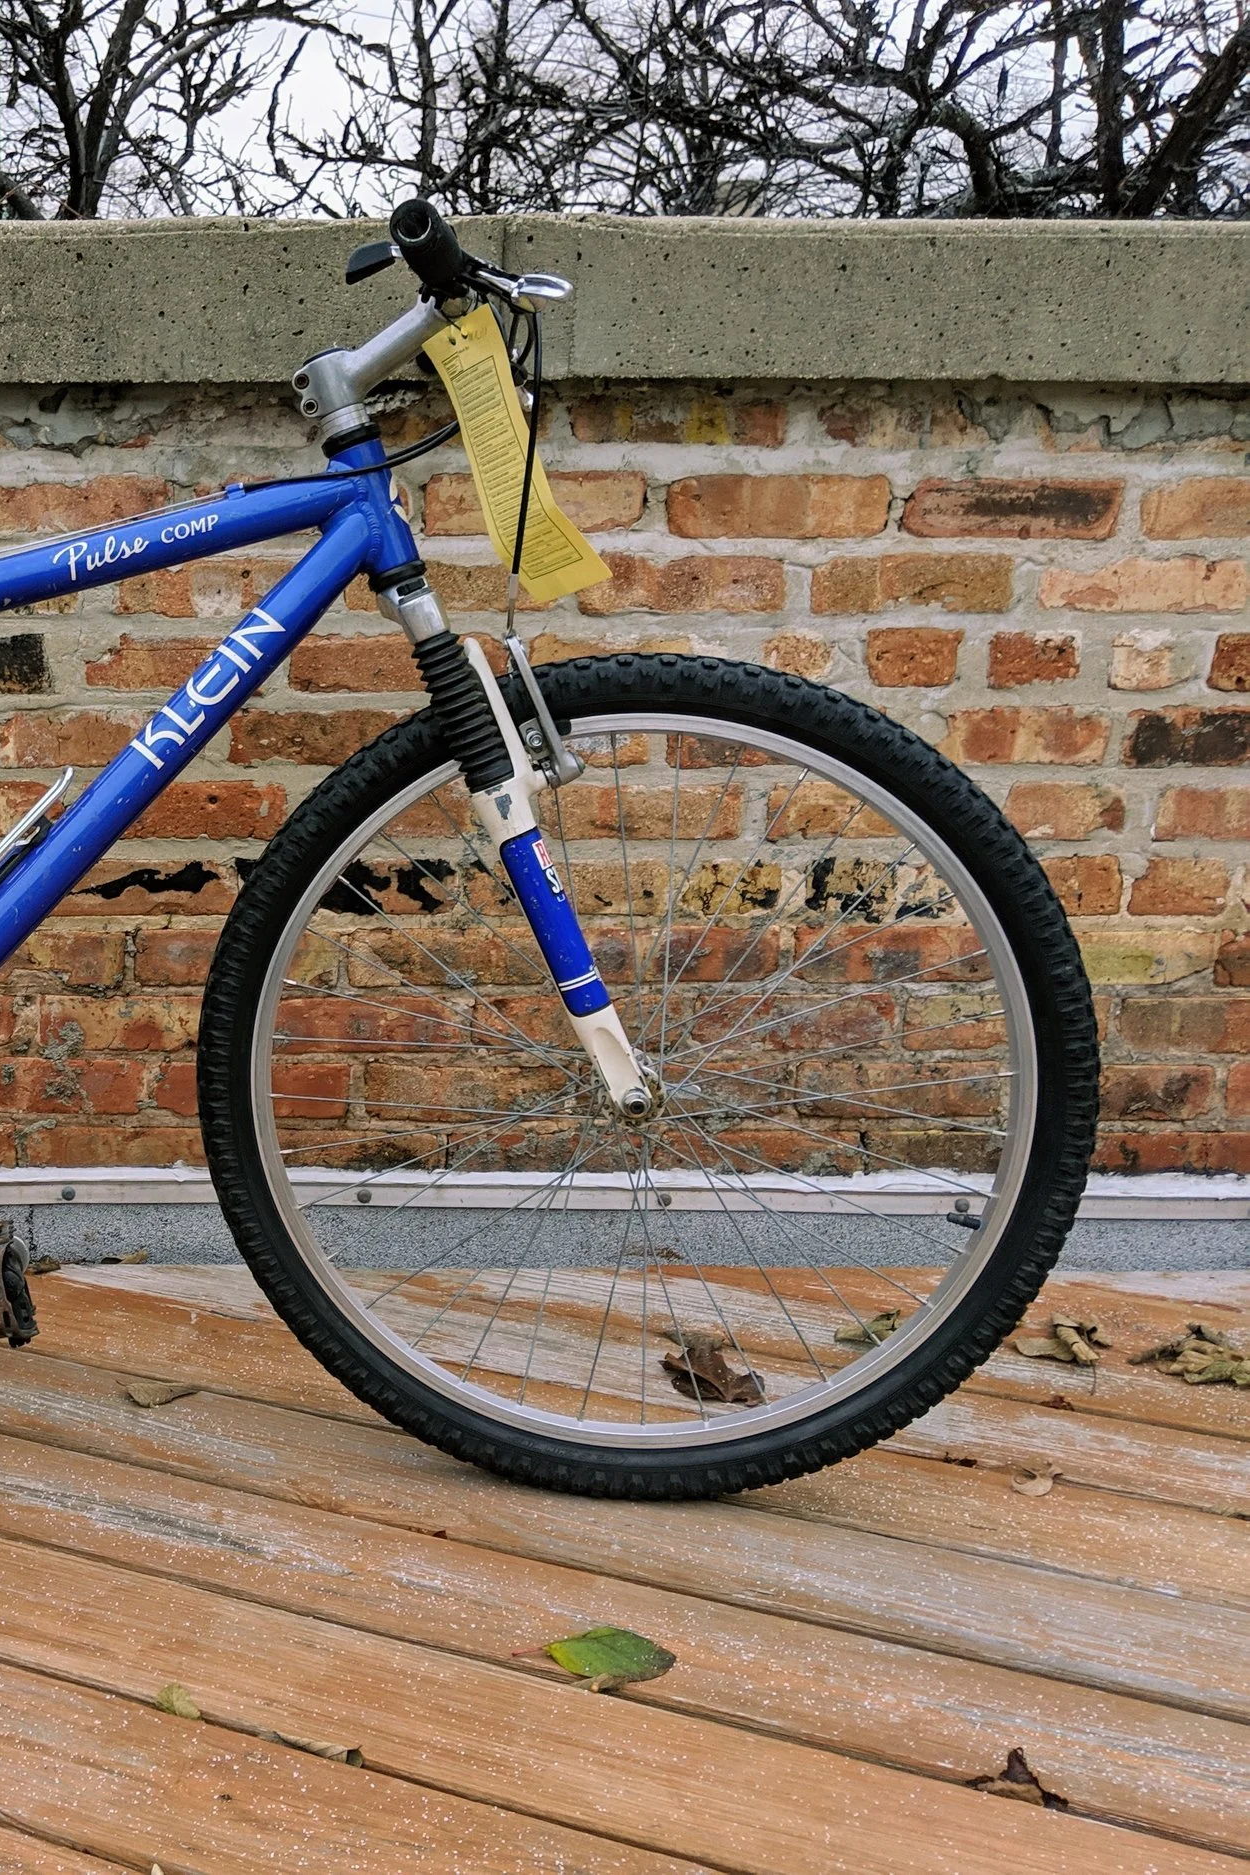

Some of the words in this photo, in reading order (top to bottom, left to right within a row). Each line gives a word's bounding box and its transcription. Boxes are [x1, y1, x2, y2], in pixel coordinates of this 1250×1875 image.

[52, 535, 149, 581] Pulse
[160, 514, 219, 544] COMP
[130, 607, 286, 770] KLEIN
